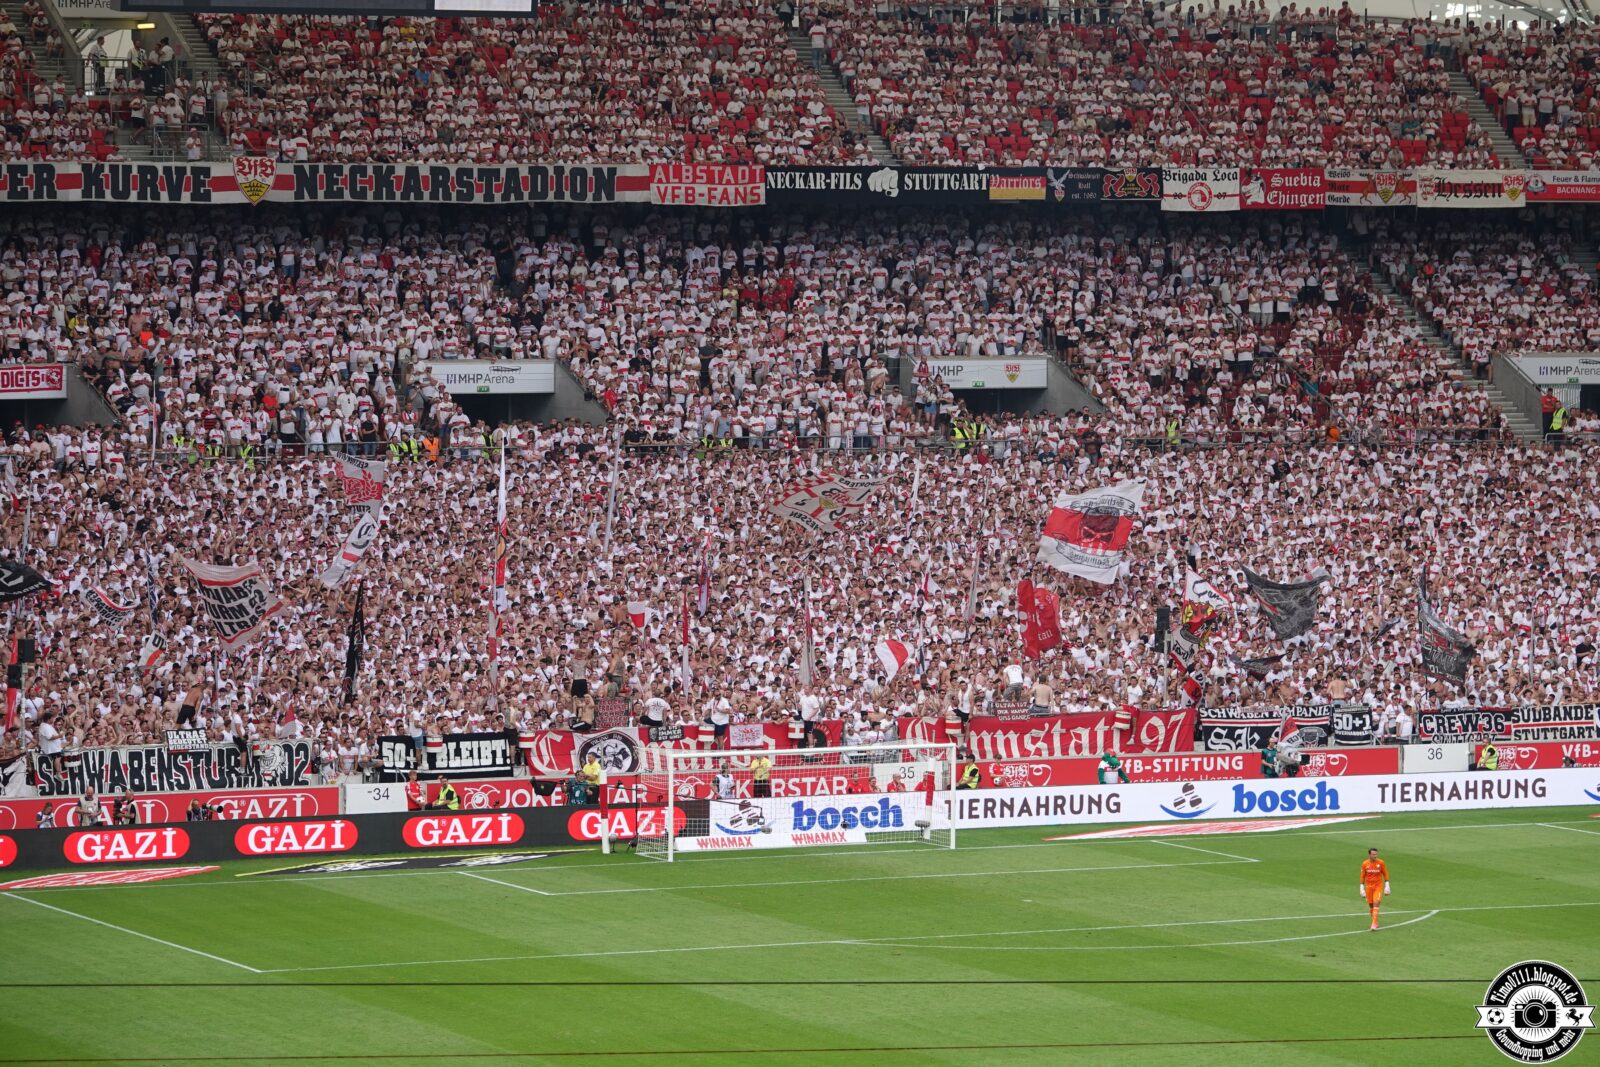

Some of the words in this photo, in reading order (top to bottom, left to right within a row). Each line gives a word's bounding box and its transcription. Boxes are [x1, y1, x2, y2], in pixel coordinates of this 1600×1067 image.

[0, 163, 57, 200] ER
[82, 163, 212, 202] KURVE
[294, 164, 617, 203] NECKARSTADION
[653, 165, 765, 184] ALBSTADT
[766, 171, 862, 190] NECKAR-FILS
[904, 172, 989, 190] STUTTGART
[989, 173, 1041, 189] Warriors
[1162, 169, 1207, 185] Brigada
[1213, 170, 1238, 182] Loca
[1271, 172, 1321, 188] Suebia
[656, 186, 762, 205] VFB-FANS
[1434, 177, 1503, 201] Hessen
[1556, 186, 1596, 194] BACKNANG
[1267, 190, 1325, 207] Ehingen
[458, 373, 483, 384] MHP
[484, 373, 515, 384] Arena
[1550, 366, 1573, 376] MHP
[1333, 713, 1371, 731] 50+1
[1422, 713, 1481, 735] CREW
[1482, 712, 1505, 733] 36
[167, 729, 207, 739] ULTRAS
[1140, 711, 1187, 753] 97
[1513, 726, 1595, 740] STUTTGART
[1427, 748, 1443, 760] 36
[280, 743, 310, 787] 02
[900, 766, 915, 779] 35
[1232, 780, 1340, 813] bosch
[1377, 777, 1547, 804] TIERNAHRUNG
[791, 797, 904, 832] bosch
[944, 792, 1121, 820] TIERNAHRUNG
[697, 836, 753, 849] WINAMAX
[791, 831, 847, 845] WINAMAX
